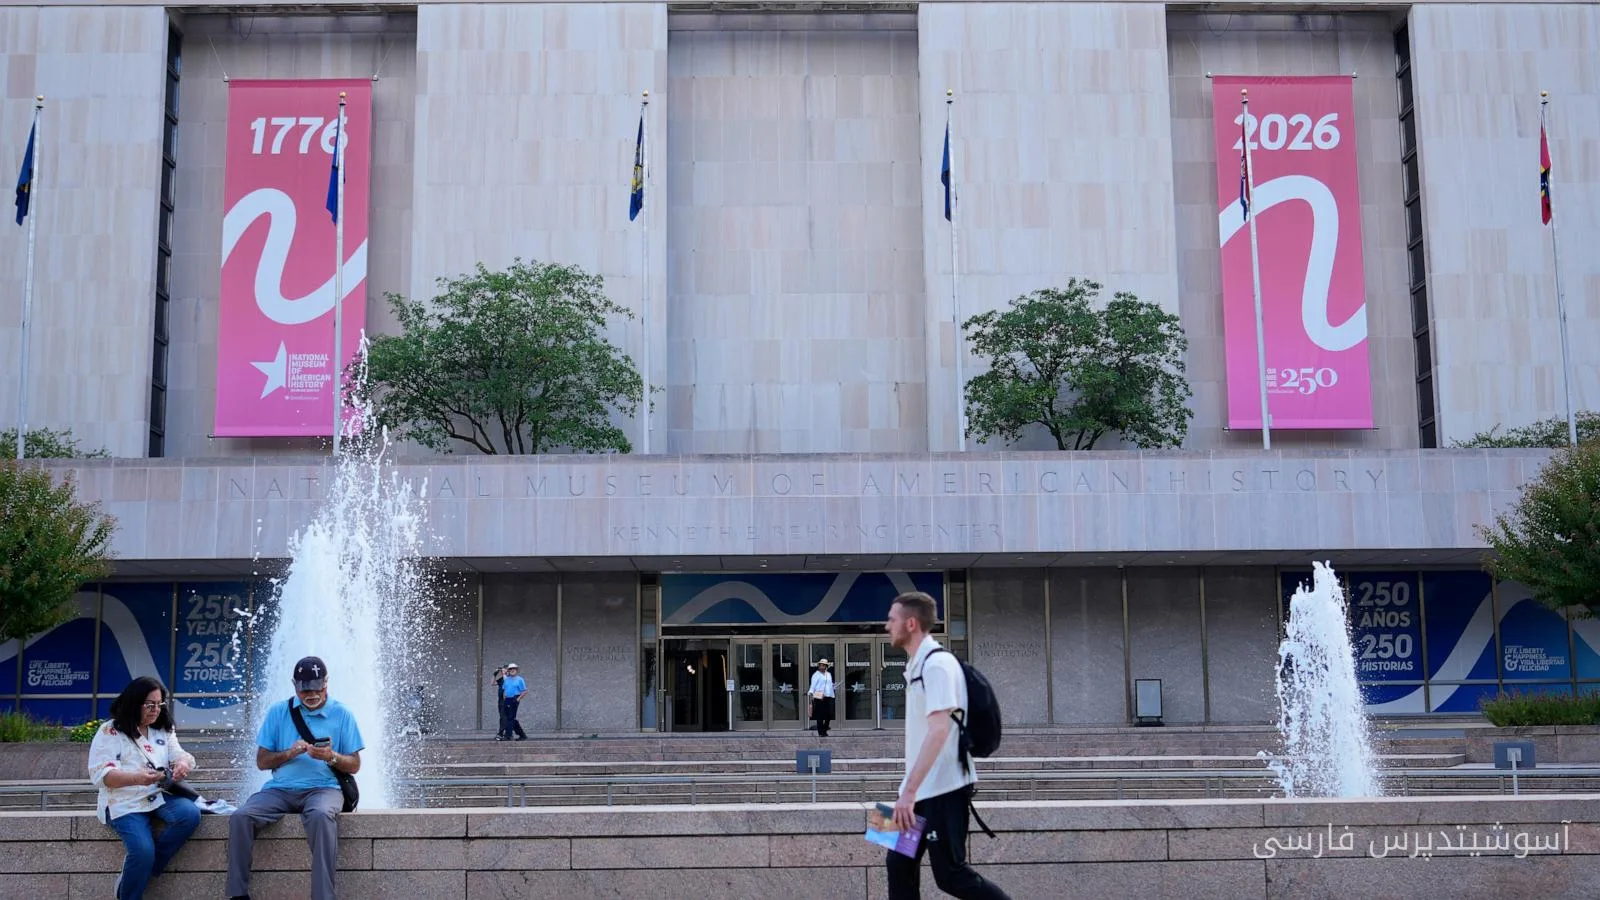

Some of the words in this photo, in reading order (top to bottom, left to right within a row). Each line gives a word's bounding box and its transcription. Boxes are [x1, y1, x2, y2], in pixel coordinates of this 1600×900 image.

[250, 117, 348, 154] 1776
[1232, 113, 1340, 151] 2026
[291, 353, 329, 361] NATIONAL
[291, 360, 326, 368] MUSEUM
[1280, 367, 1338, 395] 250
[229, 477, 491, 498] NATNAL
[526, 474, 734, 497] MUSEUM
[771, 473, 825, 496] OF
[862, 471, 1129, 495] AMERICAN
[1169, 469, 1384, 493] HISTORY
[612, 526, 733, 541] KENNETH
[772, 525, 888, 540] BEHRING
[903, 524, 1001, 539] CENTER
[187, 594, 241, 620] 250
[1358, 581, 1410, 607] 250
[1360, 608, 1411, 628] AÑOS
[1361, 633, 1413, 659] 250
[1361, 661, 1414, 672] HISTORIAS
